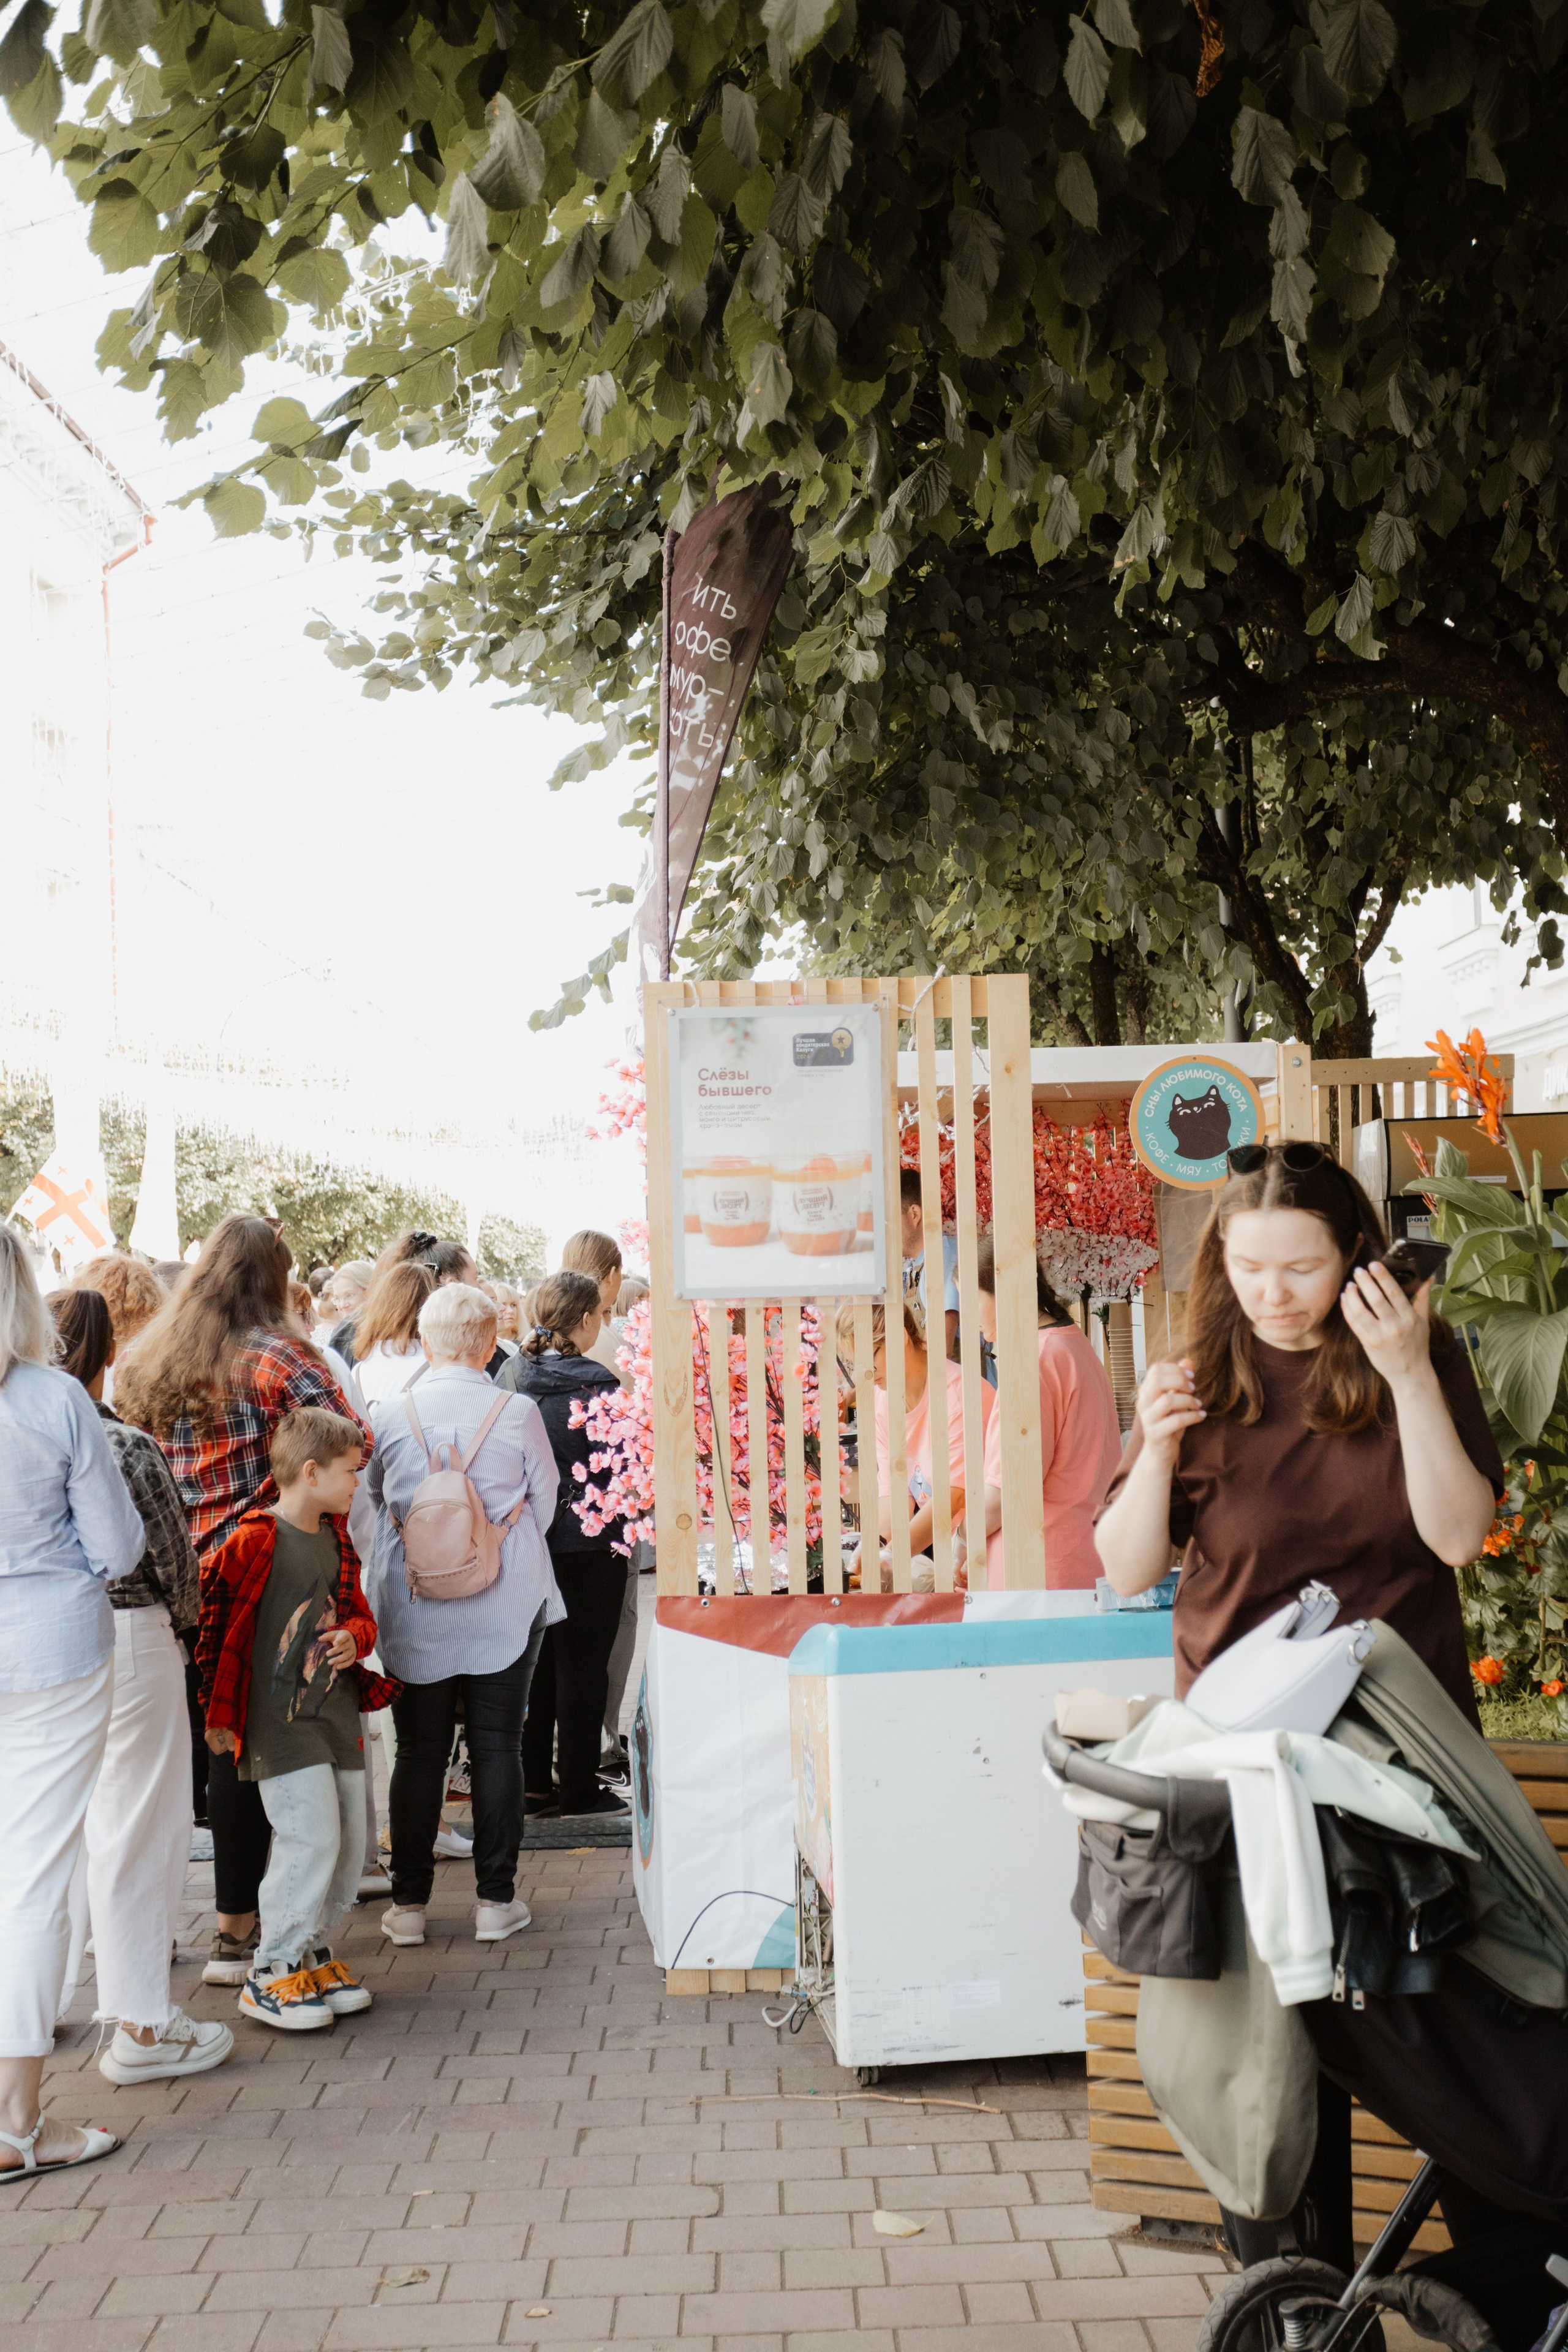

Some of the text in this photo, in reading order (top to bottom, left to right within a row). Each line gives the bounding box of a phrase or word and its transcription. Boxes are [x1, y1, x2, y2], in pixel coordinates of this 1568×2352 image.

[684, 574, 737, 620] ить
[673, 620, 731, 662] офе
[669, 708, 714, 748] ать
[698, 1068, 749, 1081] Слёзы
[698, 1084, 772, 1097] бывшего
[1145, 1069, 1248, 1117] СНЫ ЛЮБИМОГО КОТА
[1145, 1133, 1170, 1164] КОФЕ
[1176, 1163, 1201, 1176] МЯУ
